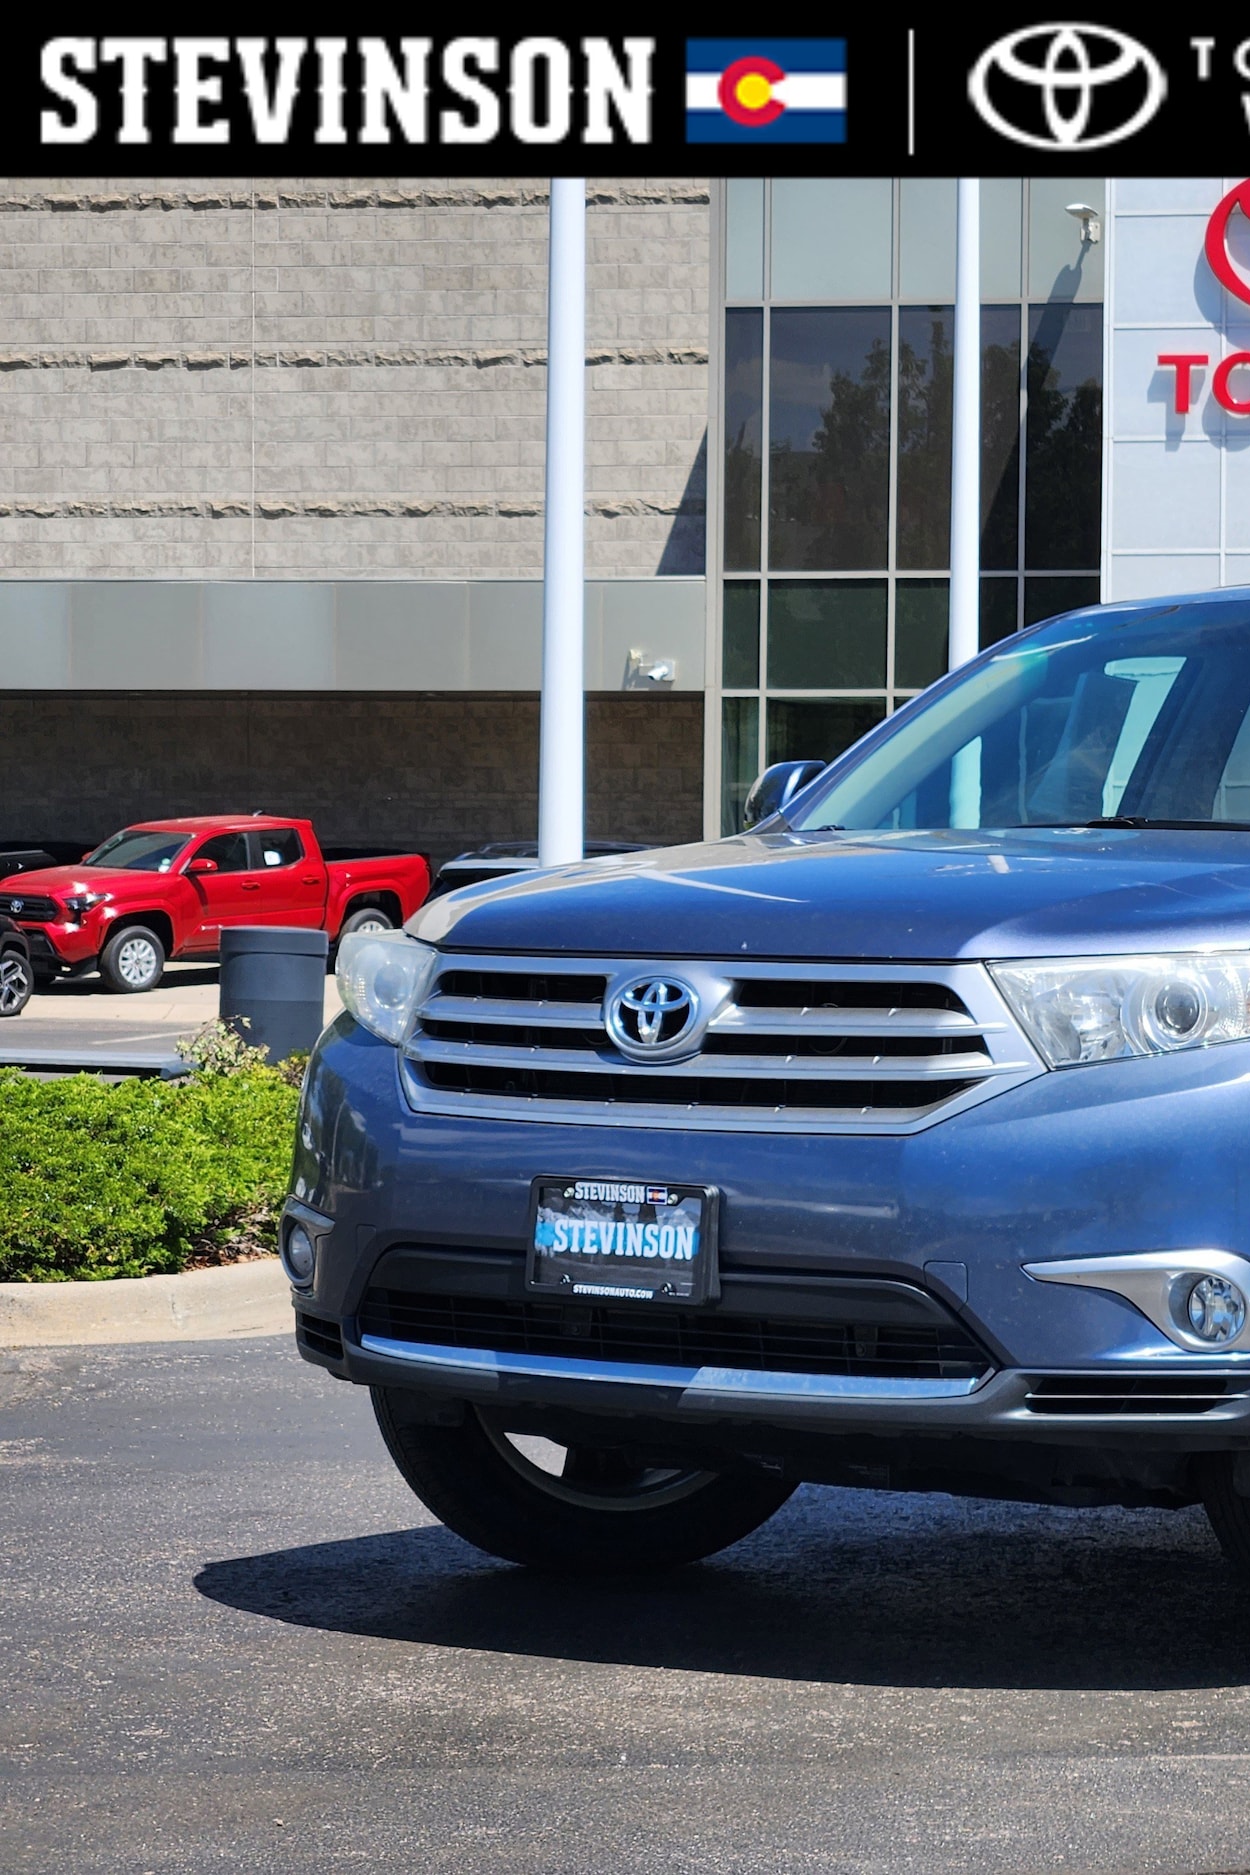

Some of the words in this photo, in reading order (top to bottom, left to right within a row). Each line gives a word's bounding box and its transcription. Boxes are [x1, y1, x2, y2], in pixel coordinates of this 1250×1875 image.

[574, 1181, 645, 1204] STEVINSON
[552, 1218, 695, 1261] STEVINSON
[573, 1284, 654, 1300] STEVINSONAUTO.COM
